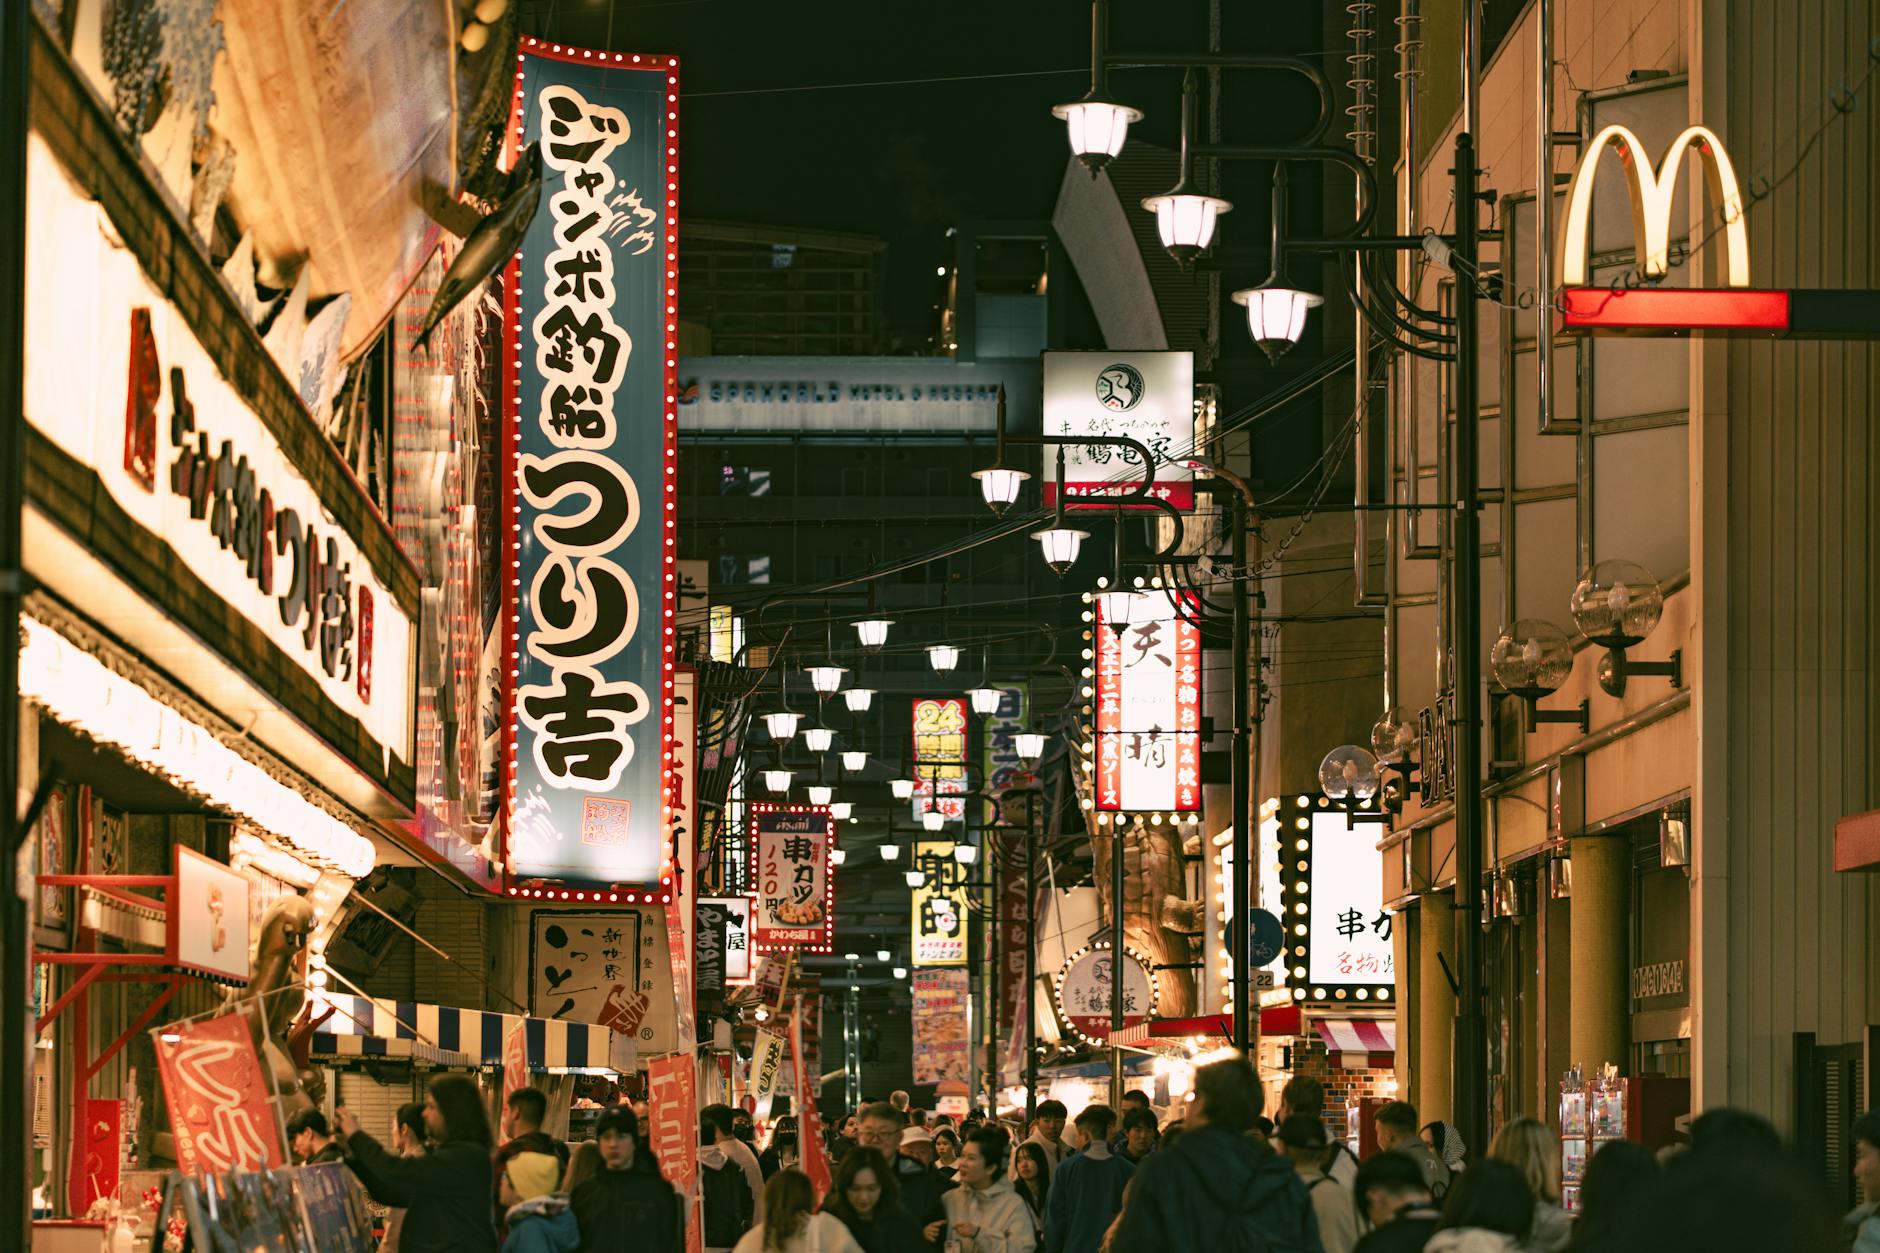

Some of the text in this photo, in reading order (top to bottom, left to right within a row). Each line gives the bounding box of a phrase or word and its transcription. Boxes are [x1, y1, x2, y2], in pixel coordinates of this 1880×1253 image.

[710, 381, 841, 403] SPAWORLD
[917, 701, 963, 733] 24
[1124, 620, 1173, 769] 天晴
[782, 835, 814, 904] 串カツ
